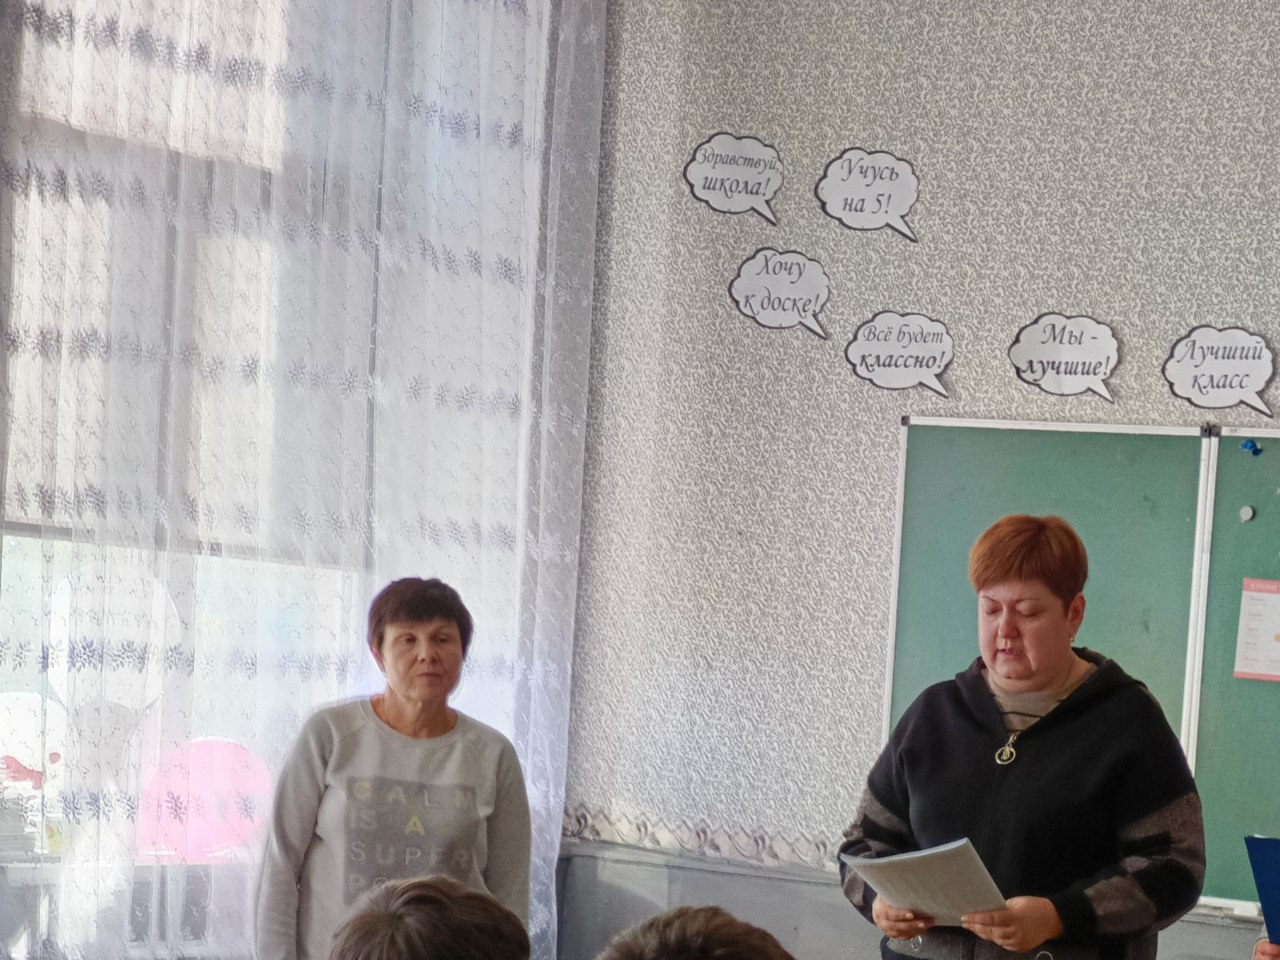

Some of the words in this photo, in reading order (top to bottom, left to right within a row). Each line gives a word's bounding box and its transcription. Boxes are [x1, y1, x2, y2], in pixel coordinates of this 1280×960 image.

[697, 147, 780, 172] Здравствуй,
[841, 158, 899, 187] Учусь
[702, 175, 770, 199] школа!
[843, 196, 866, 213] на
[871, 193, 892, 214] 5!
[756, 254, 805, 284] Хочу
[744, 294, 760, 316] к
[761, 286, 820, 318] доске!
[863, 324, 893, 343] Всё
[896, 323, 944, 348] будет
[1041, 323, 1085, 346] Мы
[859, 350, 946, 373] классно!
[1176, 339, 1265, 368] Лучший
[1021, 355, 1111, 383] лучшие!
[1191, 372, 1250, 396] класс
[404, 815, 426, 836] A
[350, 841, 470, 869] SUPER
